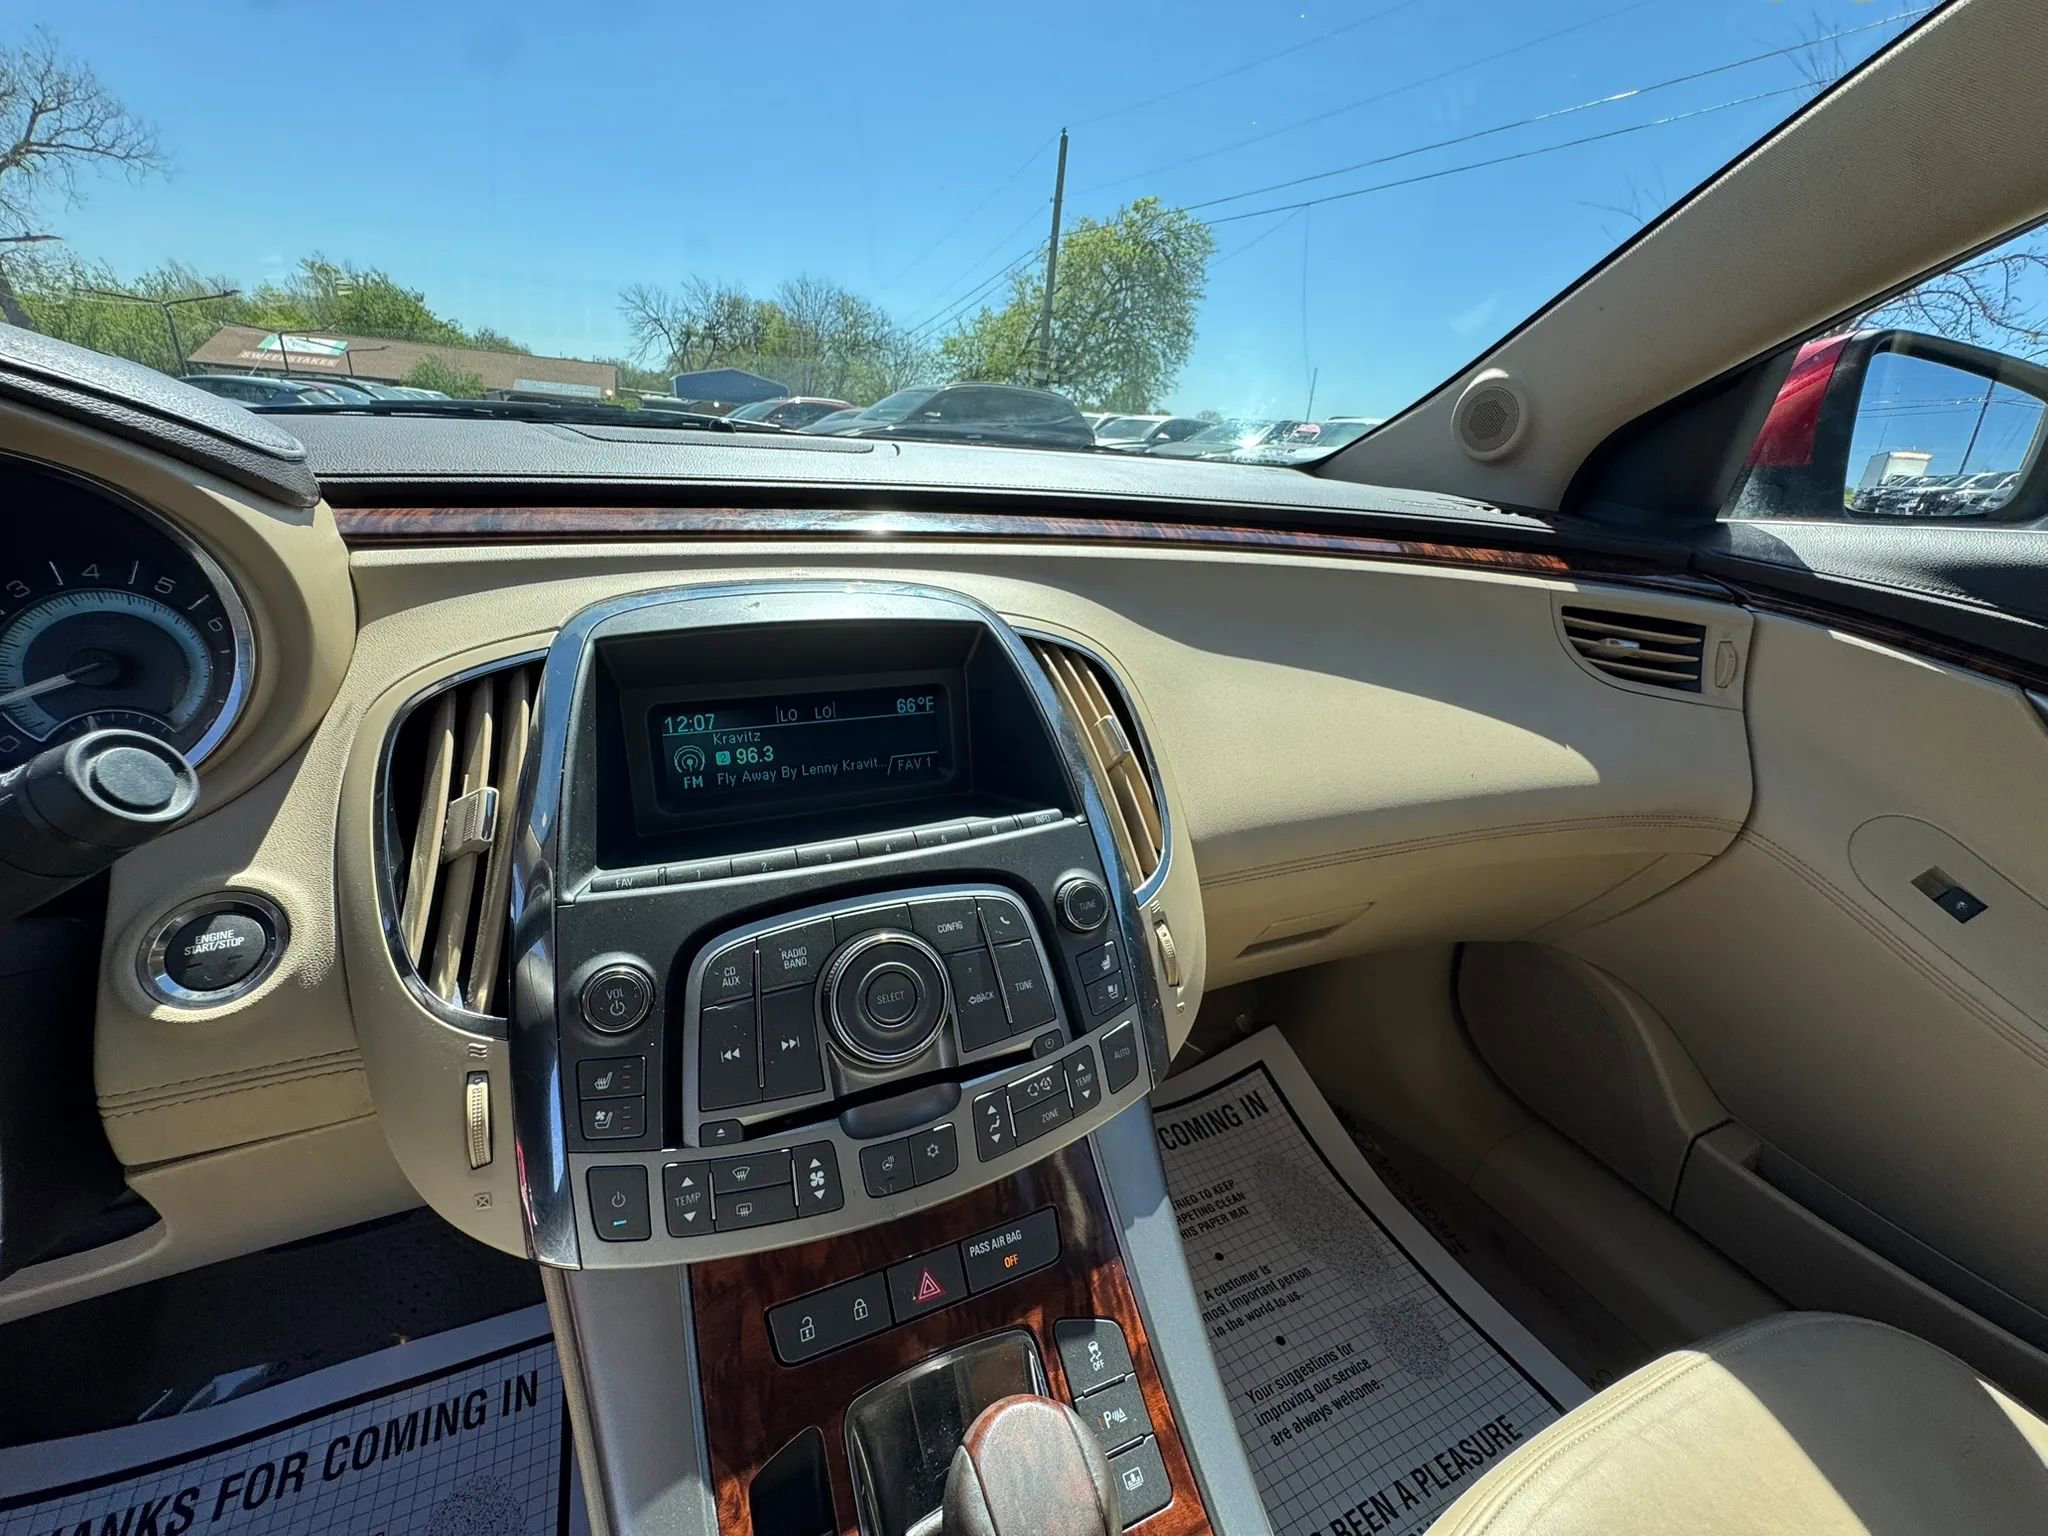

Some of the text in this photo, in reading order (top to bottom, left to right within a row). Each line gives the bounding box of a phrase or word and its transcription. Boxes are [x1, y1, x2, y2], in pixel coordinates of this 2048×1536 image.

[82, 563, 101, 579] 4
[6, 579, 31, 598] 3
[153, 576, 177, 594] 5
[207, 616, 224, 632] 6
[895, 695, 935, 714] 66°F
[663, 713, 716, 734] 12:07
[712, 730, 762, 746] Kravitz
[735, 745, 775, 765] 96.3
[896, 755, 933, 772] FAV 1
[717, 770, 737, 788] Fly
[742, 767, 778, 785] Away
[781, 765, 798, 781] By
[801, 760, 839, 777] Lenny
[683, 776, 705, 789] FM
[991, 825, 998, 834] 6
[940, 835, 948, 844] 5
[885, 844, 892, 853] 4
[761, 861, 768, 872] 2
[825, 853, 833, 864] 3
[614, 877, 635, 889] FAV
[937, 920, 964, 934] CONFIG
[194, 929, 235, 946] ENGINE
[183, 936, 245, 956] START/STOP
[781, 946, 808, 961] RADIO
[783, 957, 808, 970] BAND
[724, 966, 737, 978] CD
[721, 976, 741, 988] AUX
[1015, 980, 1034, 992] TONE
[606, 988, 625, 1001] VOL
[876, 991, 905, 1005] SELECT
[975, 990, 995, 1004] BACK
[1075, 1073, 1093, 1088] TEMP
[1040, 1108, 1060, 1124] ZONE
[1157, 1089, 1269, 1151] COMING IN
[1198, 1188, 1213, 1201] TO
[1211, 1179, 1235, 1196] KEEP
[675, 1191, 702, 1207] TEMP
[1176, 1191, 1247, 1226] RPETING CLEAN
[1180, 1205, 1250, 1240] HIS PAPER MAT
[968, 1229, 1022, 1258] PASS AIR BAG
[1003, 1253, 1019, 1269] OFF
[1203, 1264, 1272, 1302] A customer is
[1202, 1266, 1312, 1324] most important person
[1211, 1325, 1227, 1338] in
[1224, 1316, 1246, 1333] the
[1243, 1301, 1276, 1323] world
[1273, 1296, 1287, 1309] to
[1092, 1360, 1105, 1372] OFF
[1245, 1342, 1356, 1404] Your suggestions for
[1254, 1358, 1373, 1427] improving our service
[1270, 1427, 1293, 1447] are
[1291, 1403, 1334, 1434] always
[211, 1451, 310, 1523] FOR
[322, 1388, 488, 1482] COMING
[502, 1369, 539, 1418] IN
[1392, 1479, 1420, 1511] A
[1410, 1414, 1524, 1498] PLEASURE
